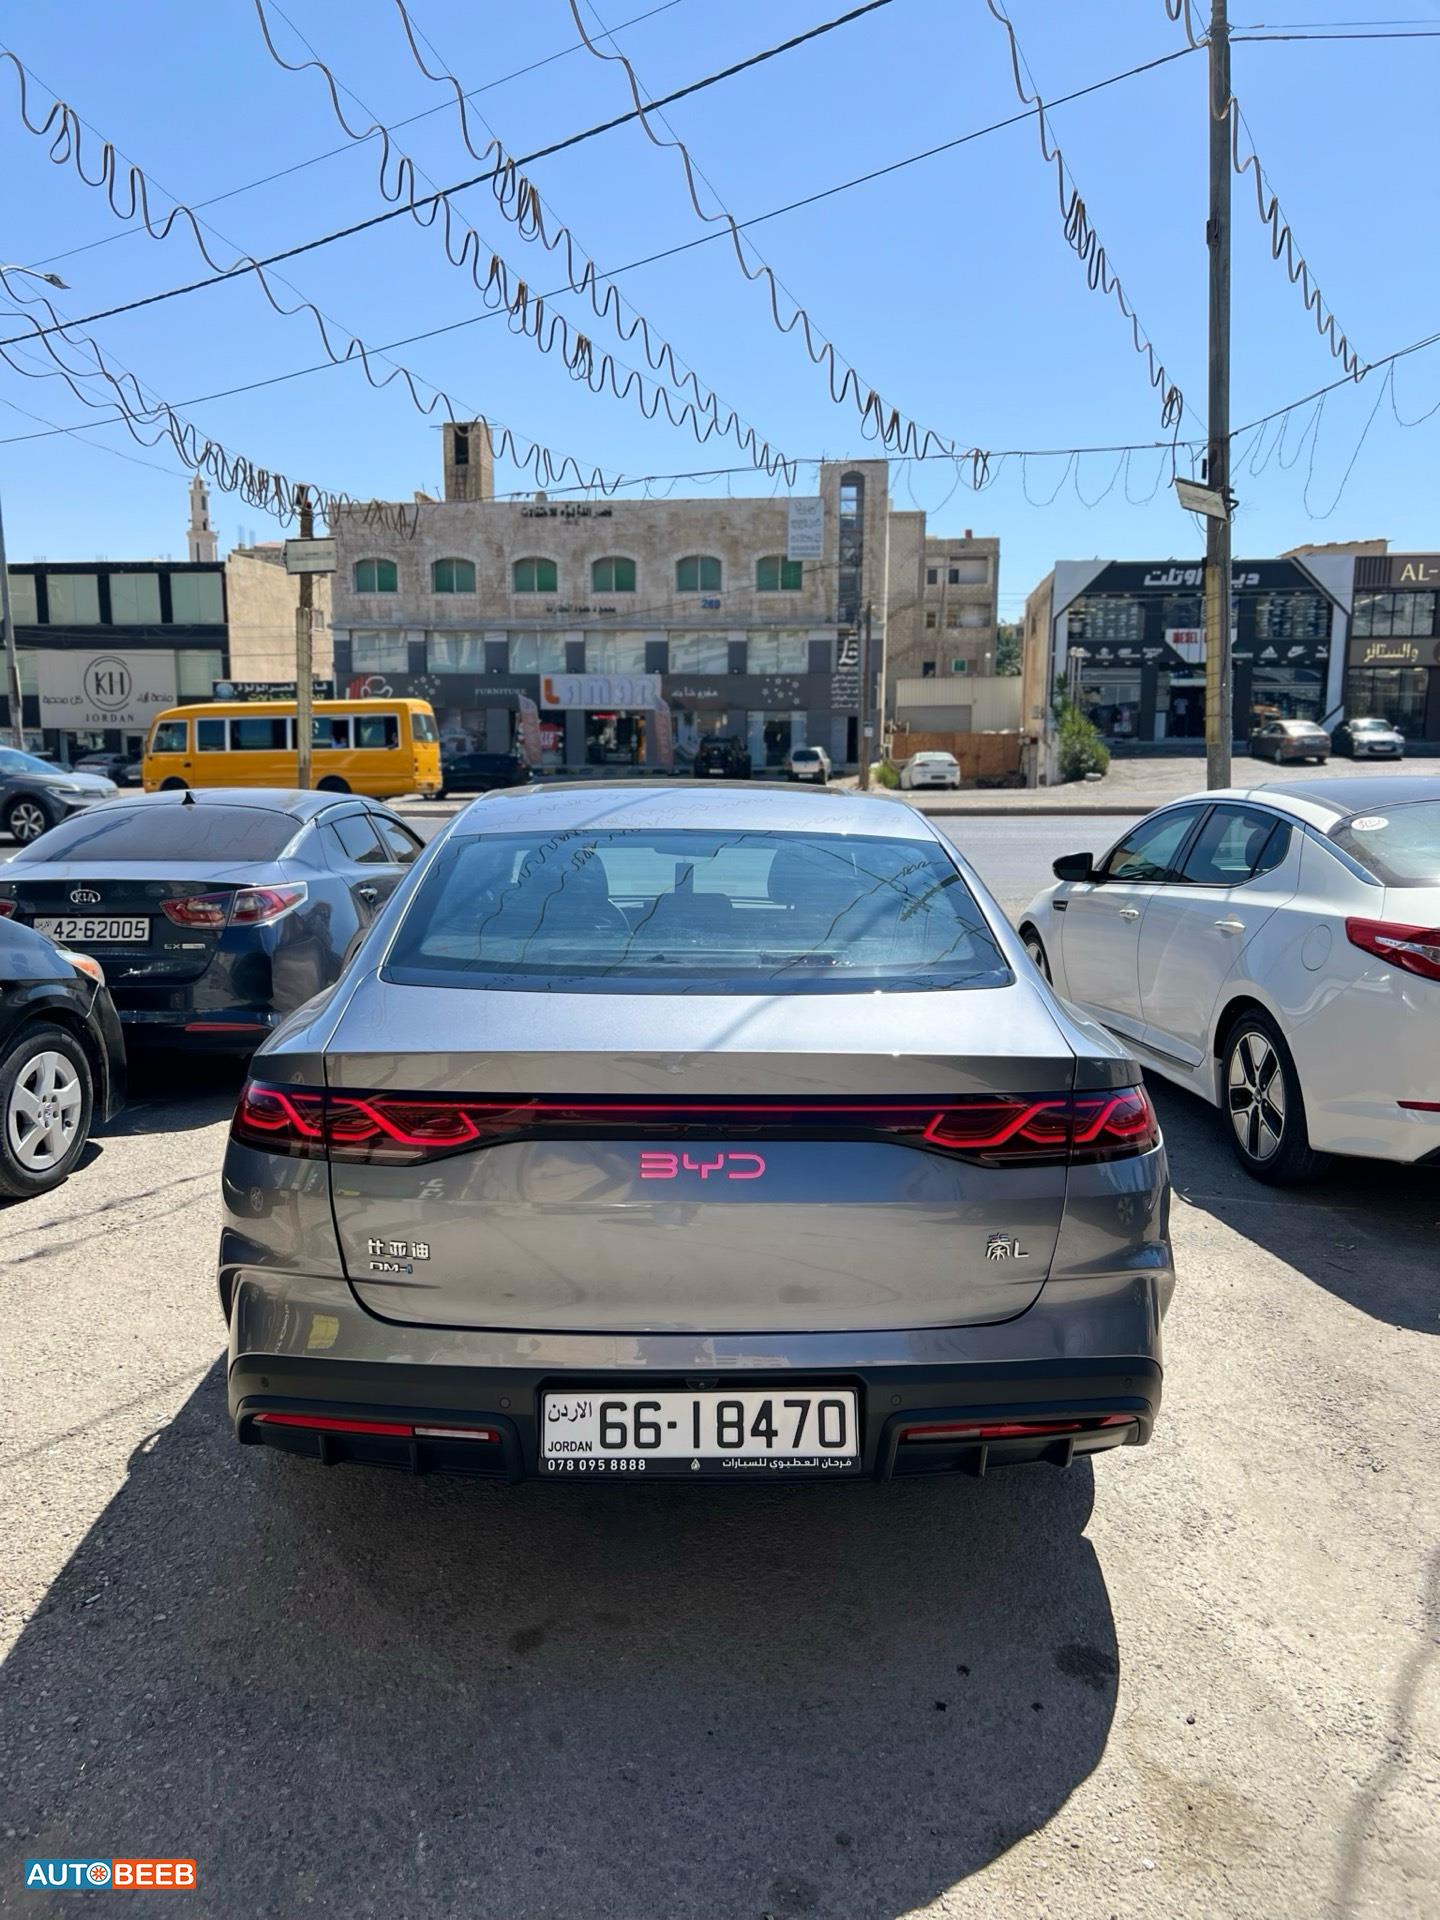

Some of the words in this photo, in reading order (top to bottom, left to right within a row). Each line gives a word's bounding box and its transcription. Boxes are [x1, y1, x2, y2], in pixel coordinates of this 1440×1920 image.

[94, 671, 125, 695] KH
[475, 688, 528, 696] FURNITURE
[85, 713, 135, 723] JORDAN
[53, 920, 146, 939] 42-62005
[641, 1153, 766, 1179] BYD
[368, 1238, 430, 1259] 比亚迪
[600, 1400, 847, 1449] 66-18470
[548, 1440, 593, 1452] JORDAN
[548, 1459, 574, 1471] 078
[579, 1459, 605, 1471] 095
[610, 1459, 646, 1471] 8888
[722, 1457, 767, 1468] للسيارات
[821, 1457, 852, 1469] فرحان
